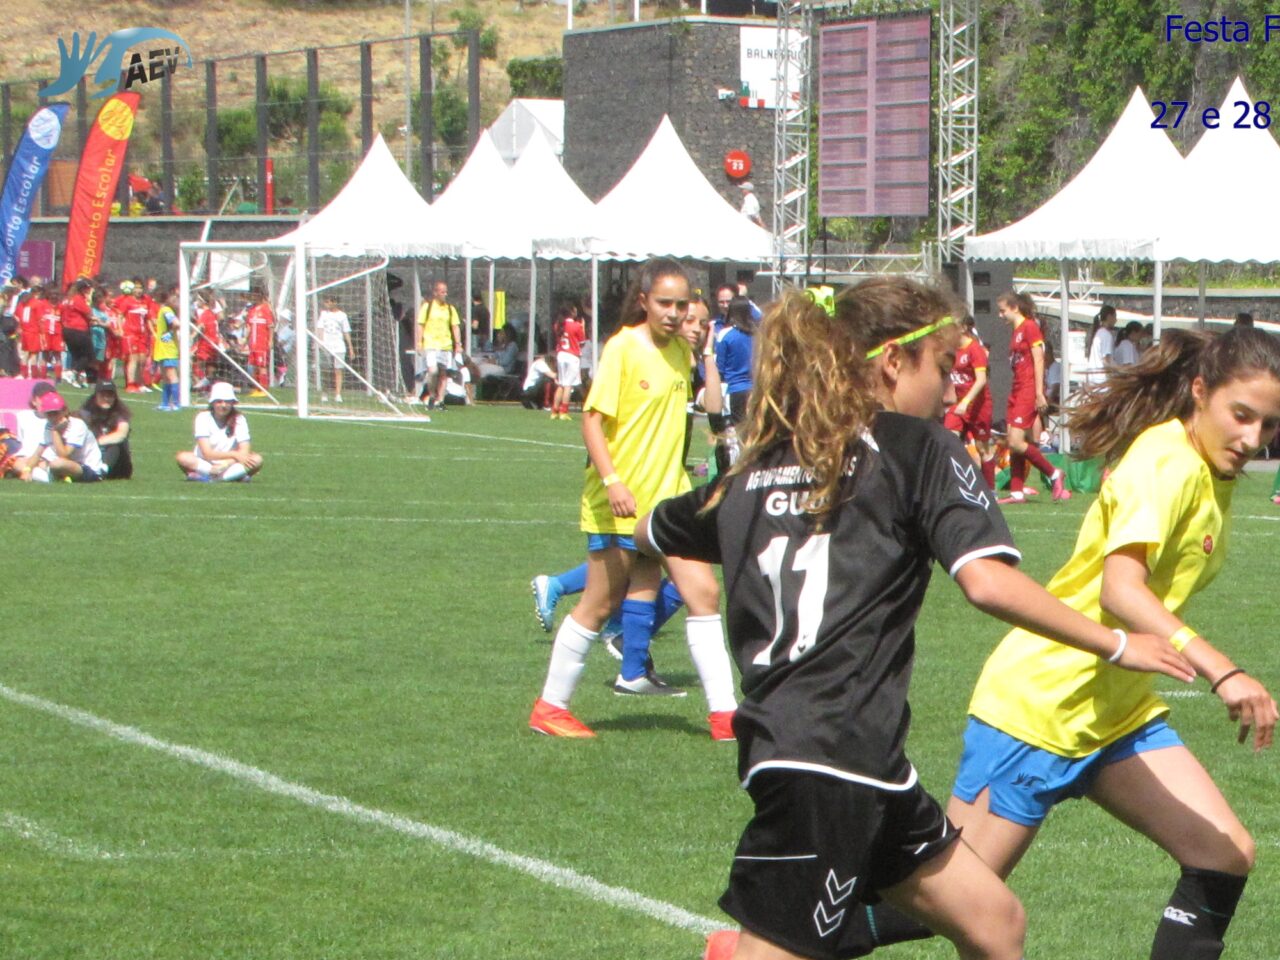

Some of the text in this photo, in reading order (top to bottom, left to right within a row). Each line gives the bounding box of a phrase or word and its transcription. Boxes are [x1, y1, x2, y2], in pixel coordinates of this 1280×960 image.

[13, 155, 41, 214] Escolar
[92, 149, 117, 209] Escolar
[752, 533, 831, 666] 11
